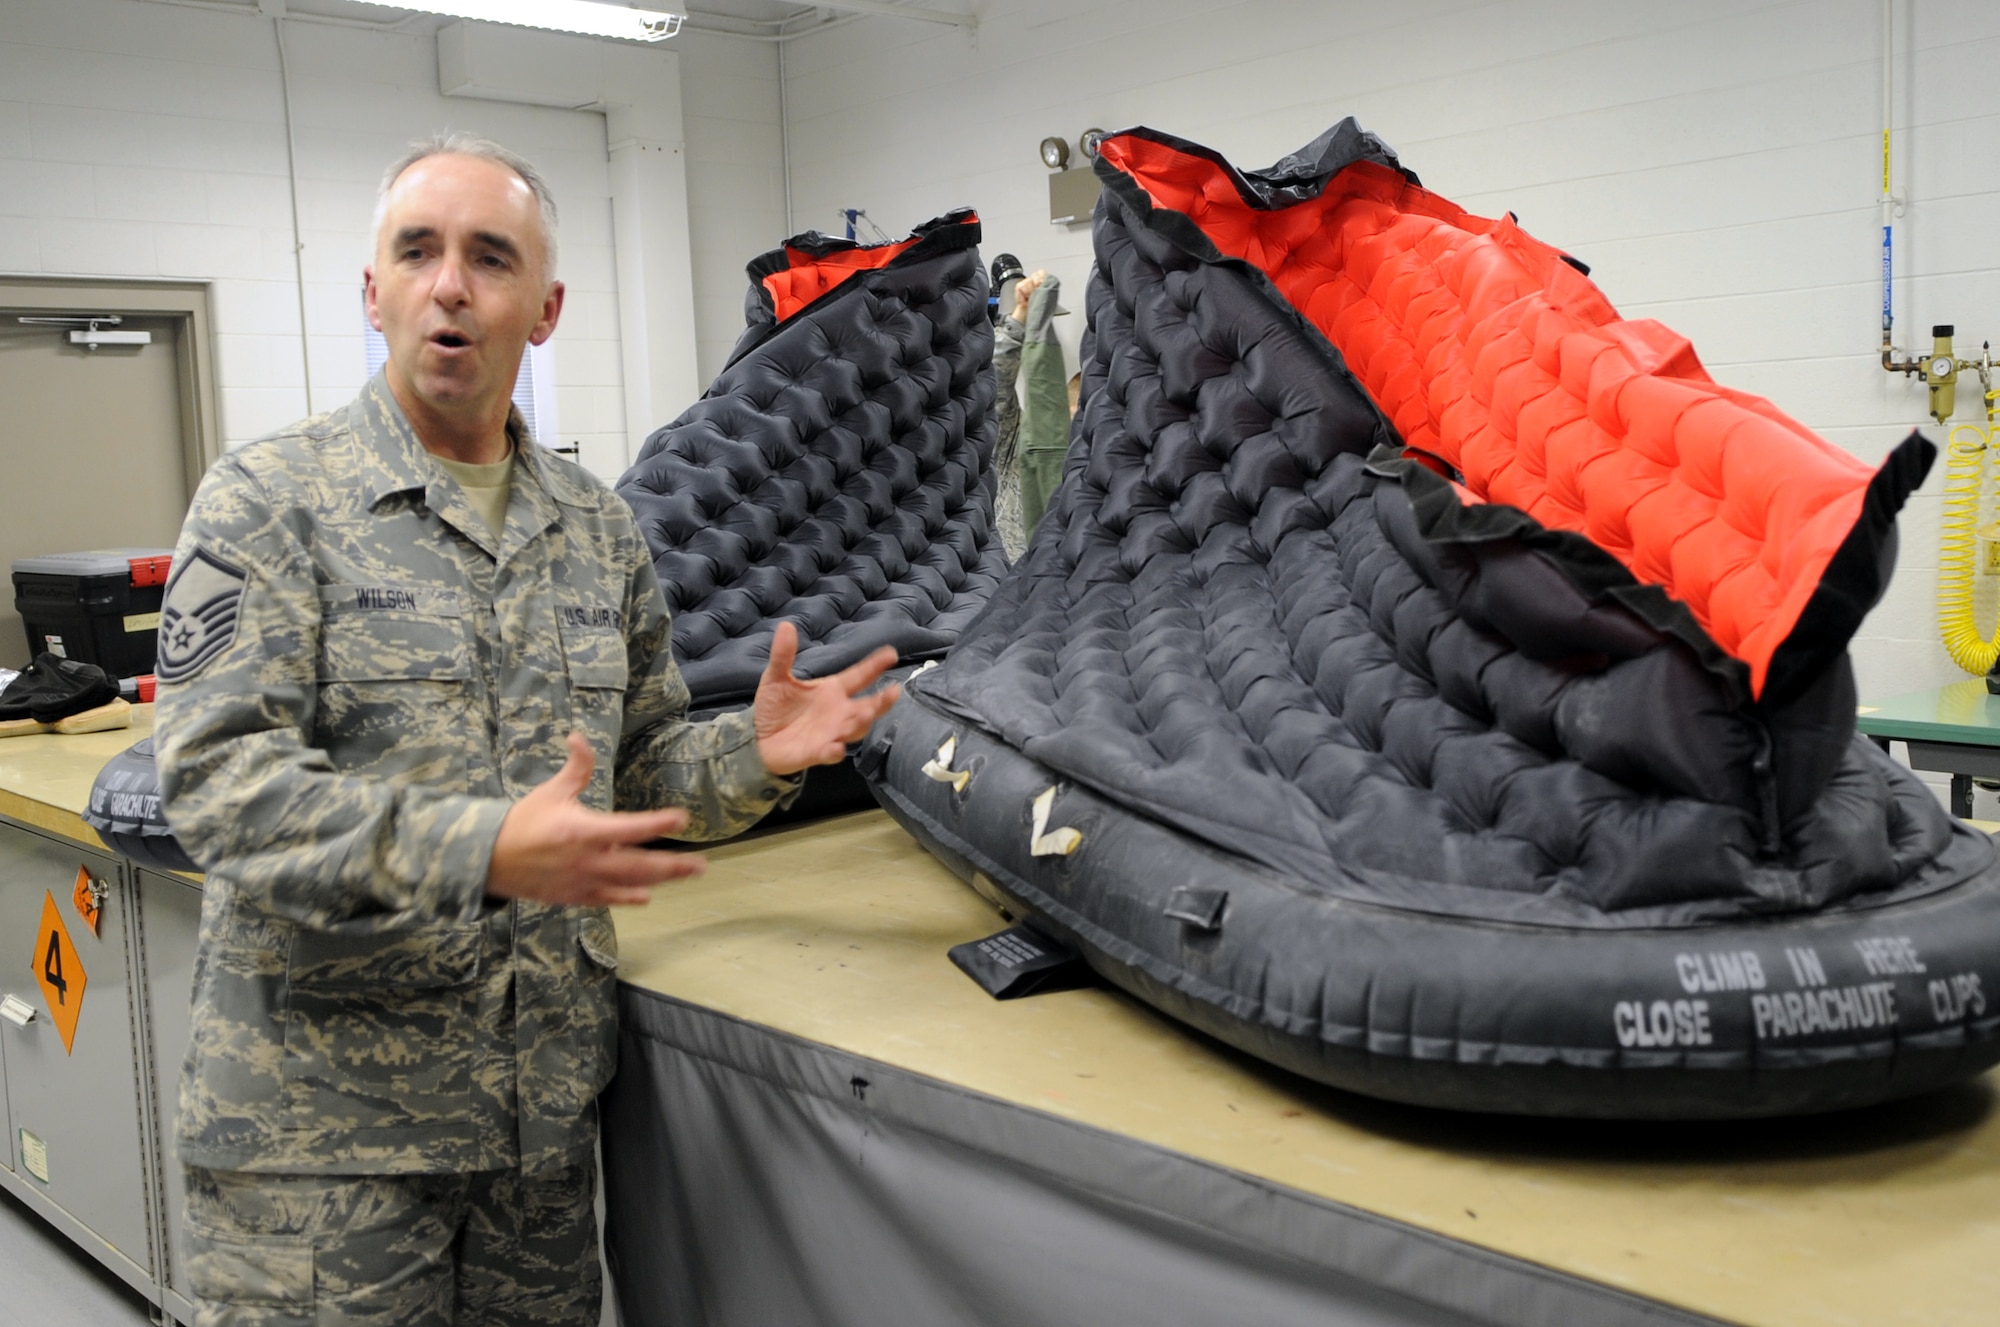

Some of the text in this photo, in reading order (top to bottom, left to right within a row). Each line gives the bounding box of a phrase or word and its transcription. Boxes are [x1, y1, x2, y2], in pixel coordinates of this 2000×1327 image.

[355, 588, 416, 611] WILSON
[564, 607, 590, 626] U.S.
[592, 608, 612, 628] AIR
[45, 929, 67, 1007] 4
[1674, 936, 1927, 993] CLIMB IN HERE
[1613, 972, 1987, 1047] CLOSE PARACHUTE CLIPS
